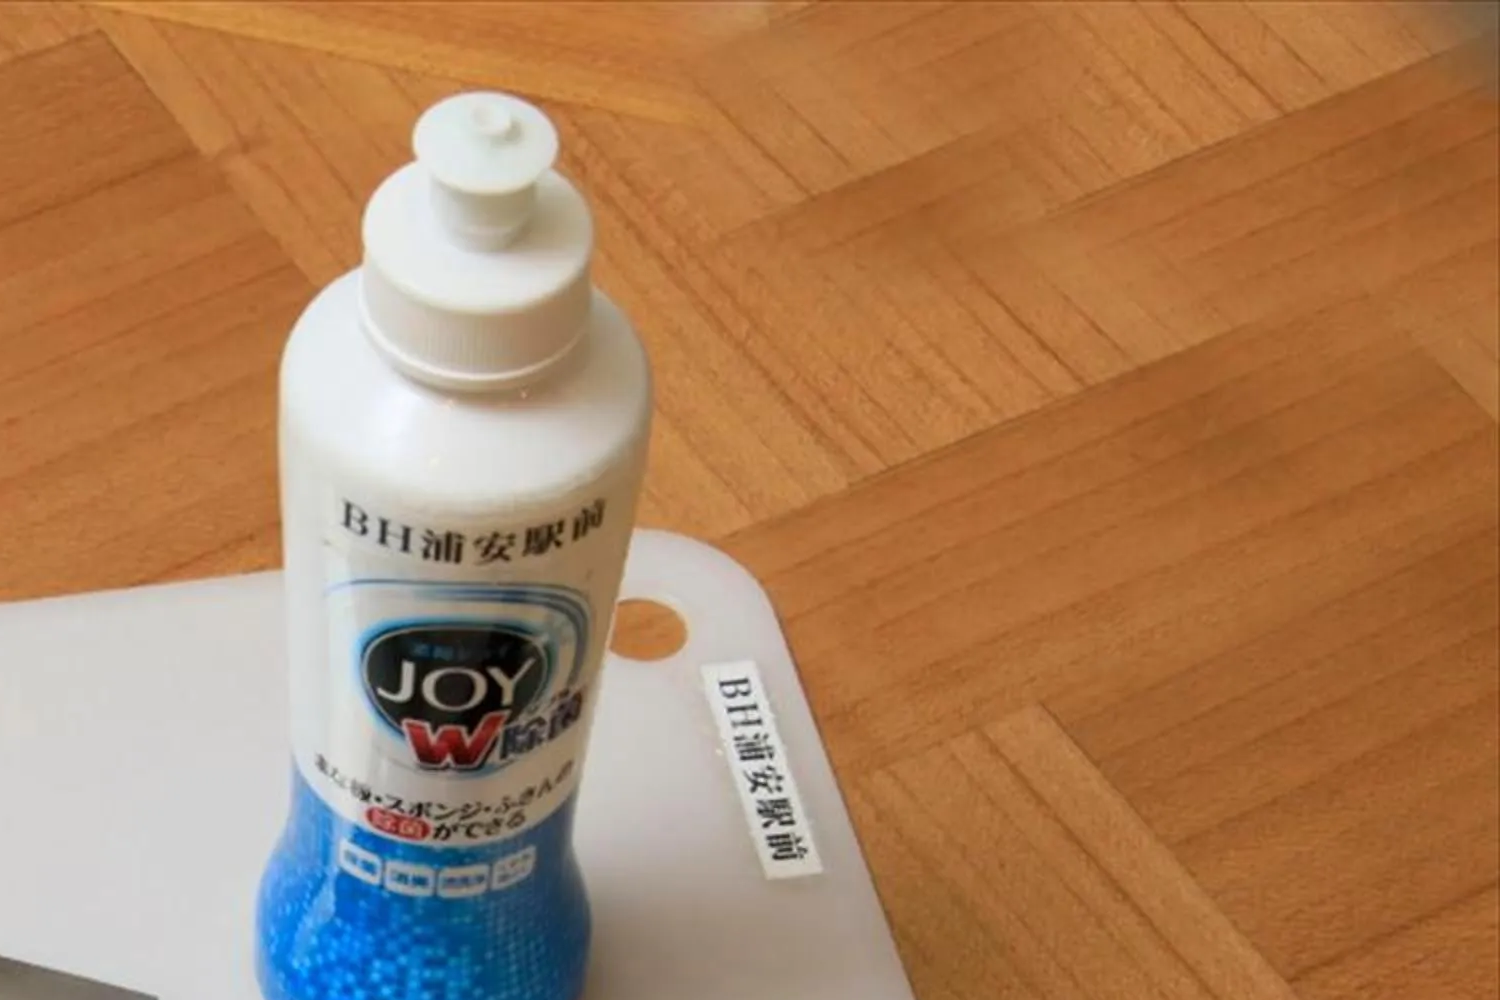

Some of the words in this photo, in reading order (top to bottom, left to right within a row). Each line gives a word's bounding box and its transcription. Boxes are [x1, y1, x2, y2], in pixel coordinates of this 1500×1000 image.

[340, 498, 606, 565] BH浦安駅前
[376, 656, 536, 711] JOY
[719, 677, 809, 862] BH浦安駅前
